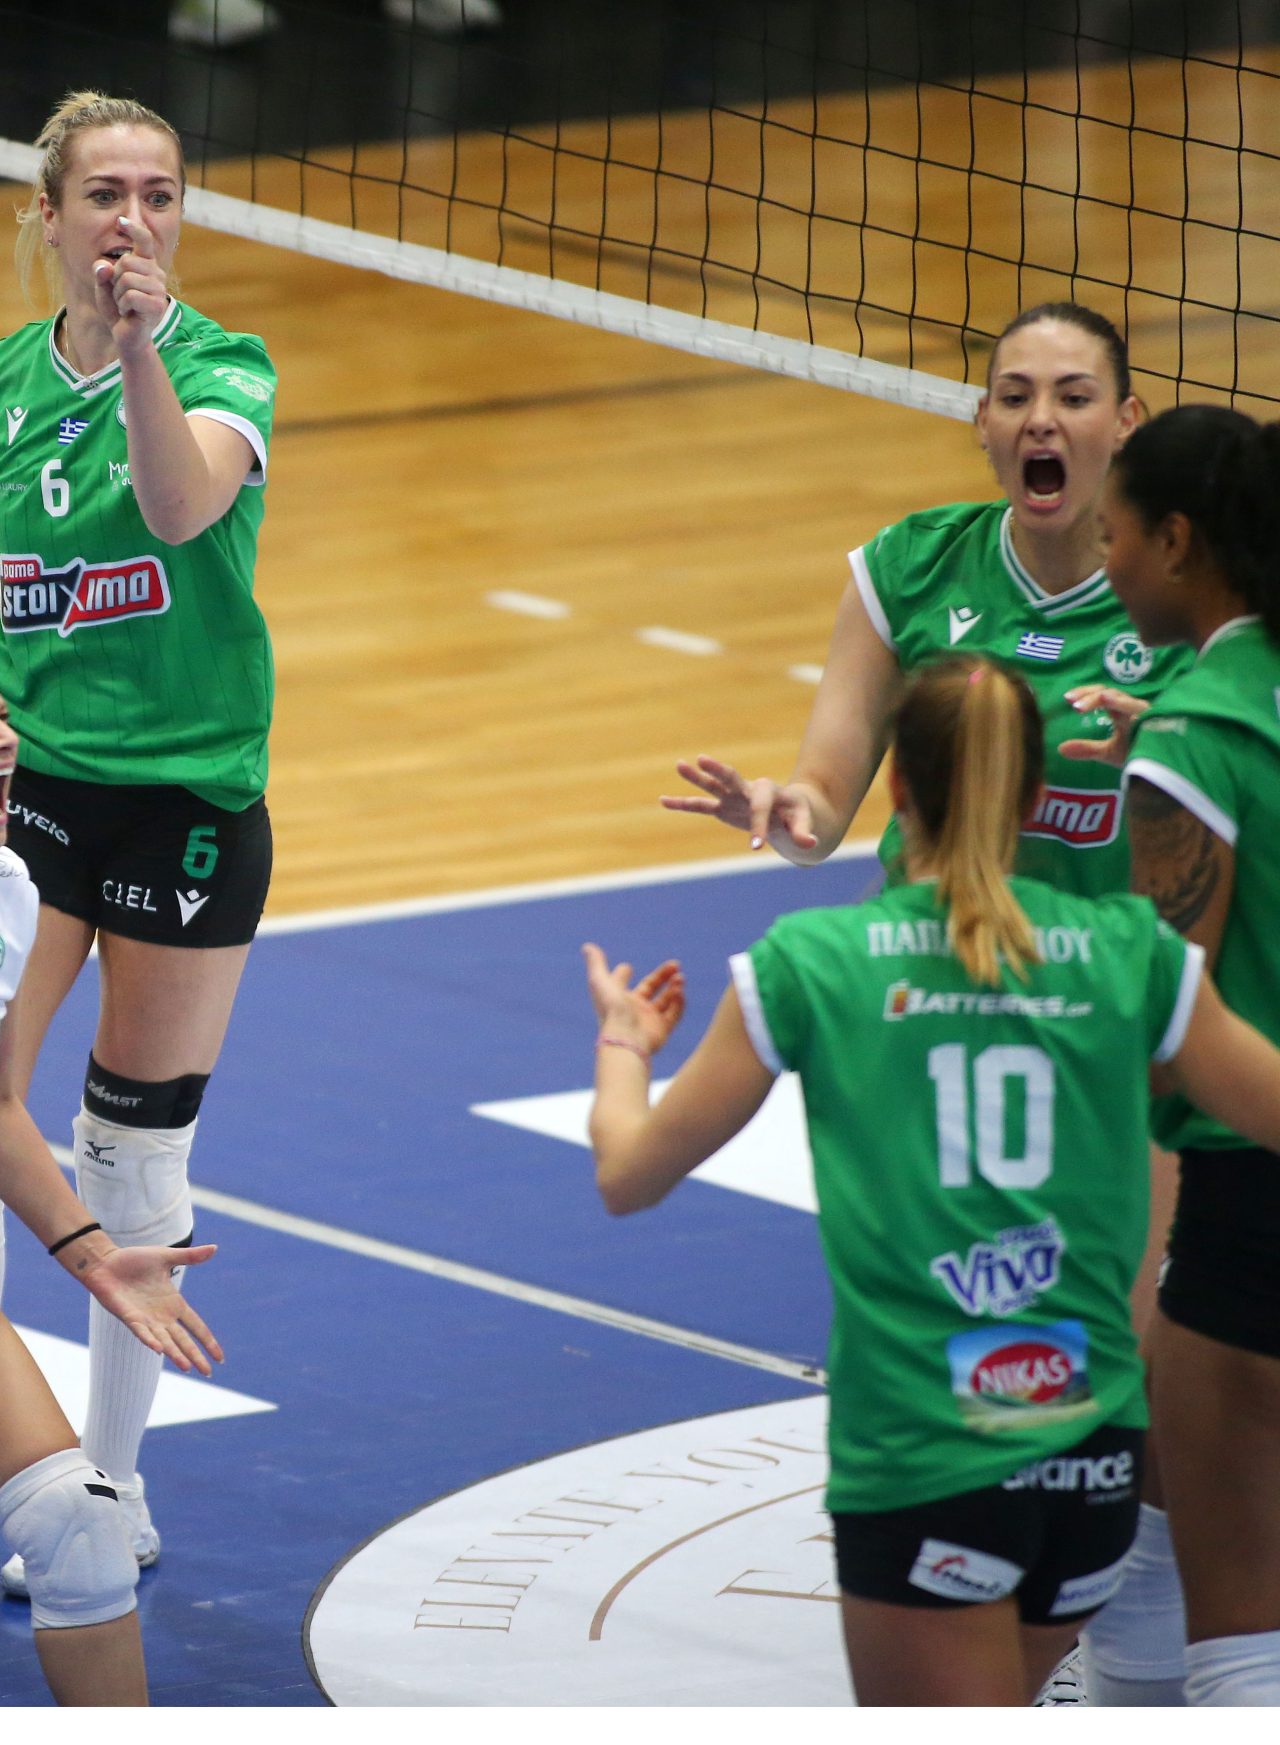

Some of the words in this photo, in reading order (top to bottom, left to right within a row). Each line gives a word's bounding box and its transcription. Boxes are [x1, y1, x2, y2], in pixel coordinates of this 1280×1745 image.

[41, 459, 70, 518] 6
[3, 563, 35, 577] pame
[182, 826, 219, 879] 6
[102, 880, 157, 912] CIEL
[929, 1044, 1055, 1190] 10
[978, 1354, 1068, 1395] NIKAS
